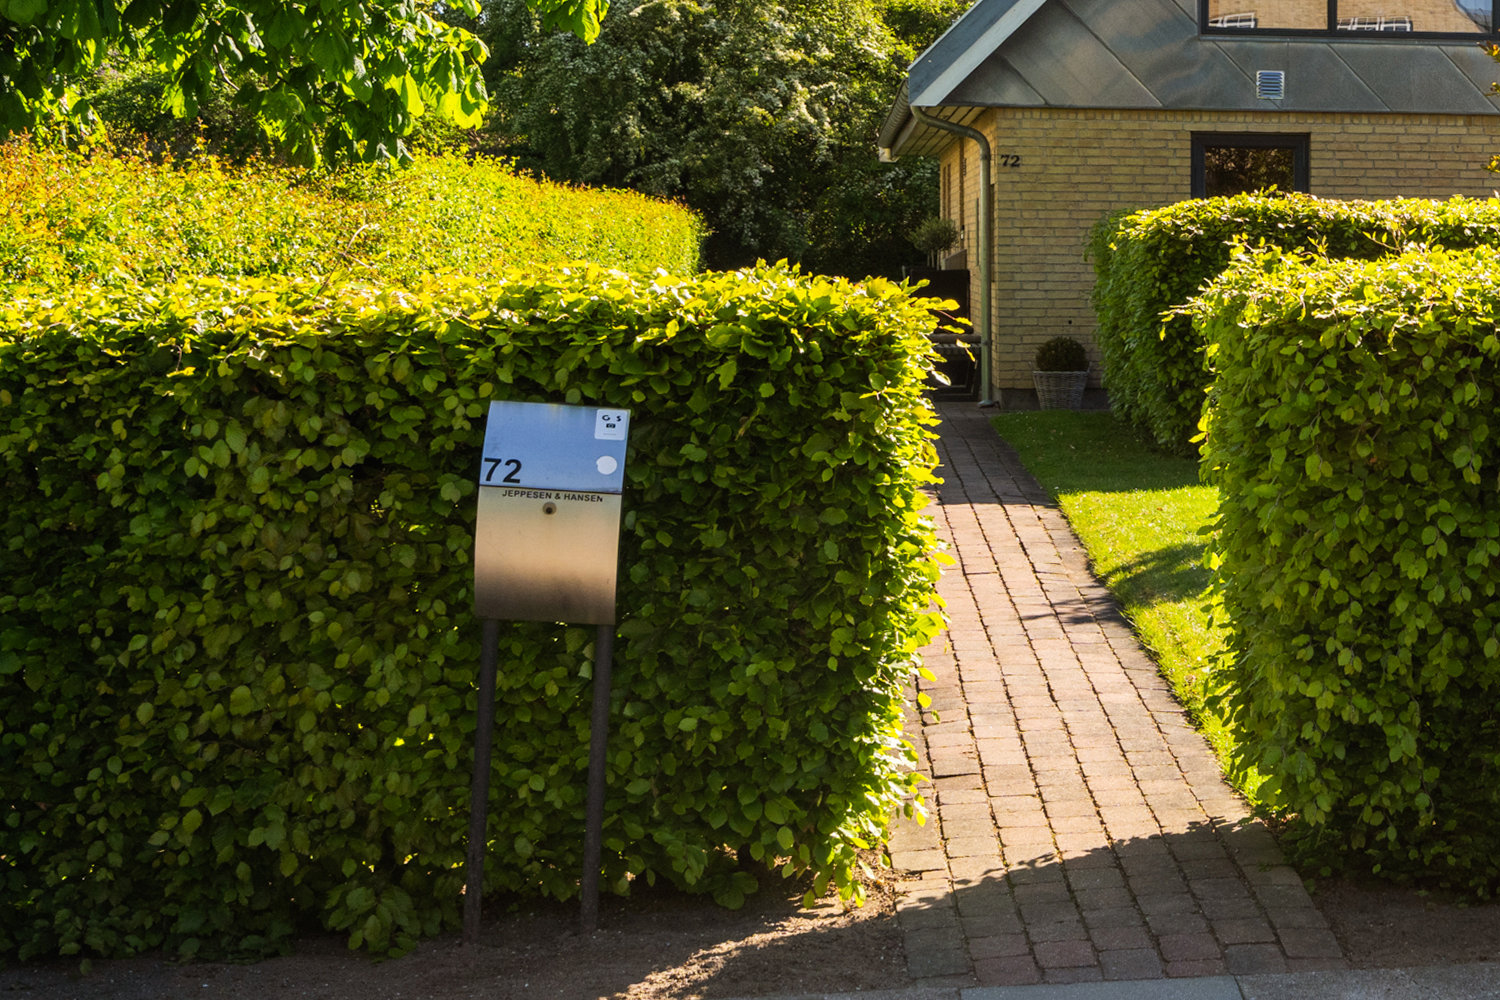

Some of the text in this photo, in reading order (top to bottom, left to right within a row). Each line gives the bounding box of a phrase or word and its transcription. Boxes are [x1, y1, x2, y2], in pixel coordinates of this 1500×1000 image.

[1000, 154, 1021, 168] 72
[484, 457, 522, 484] 72
[502, 489, 604, 503] JEPPESEN & HANSEN
